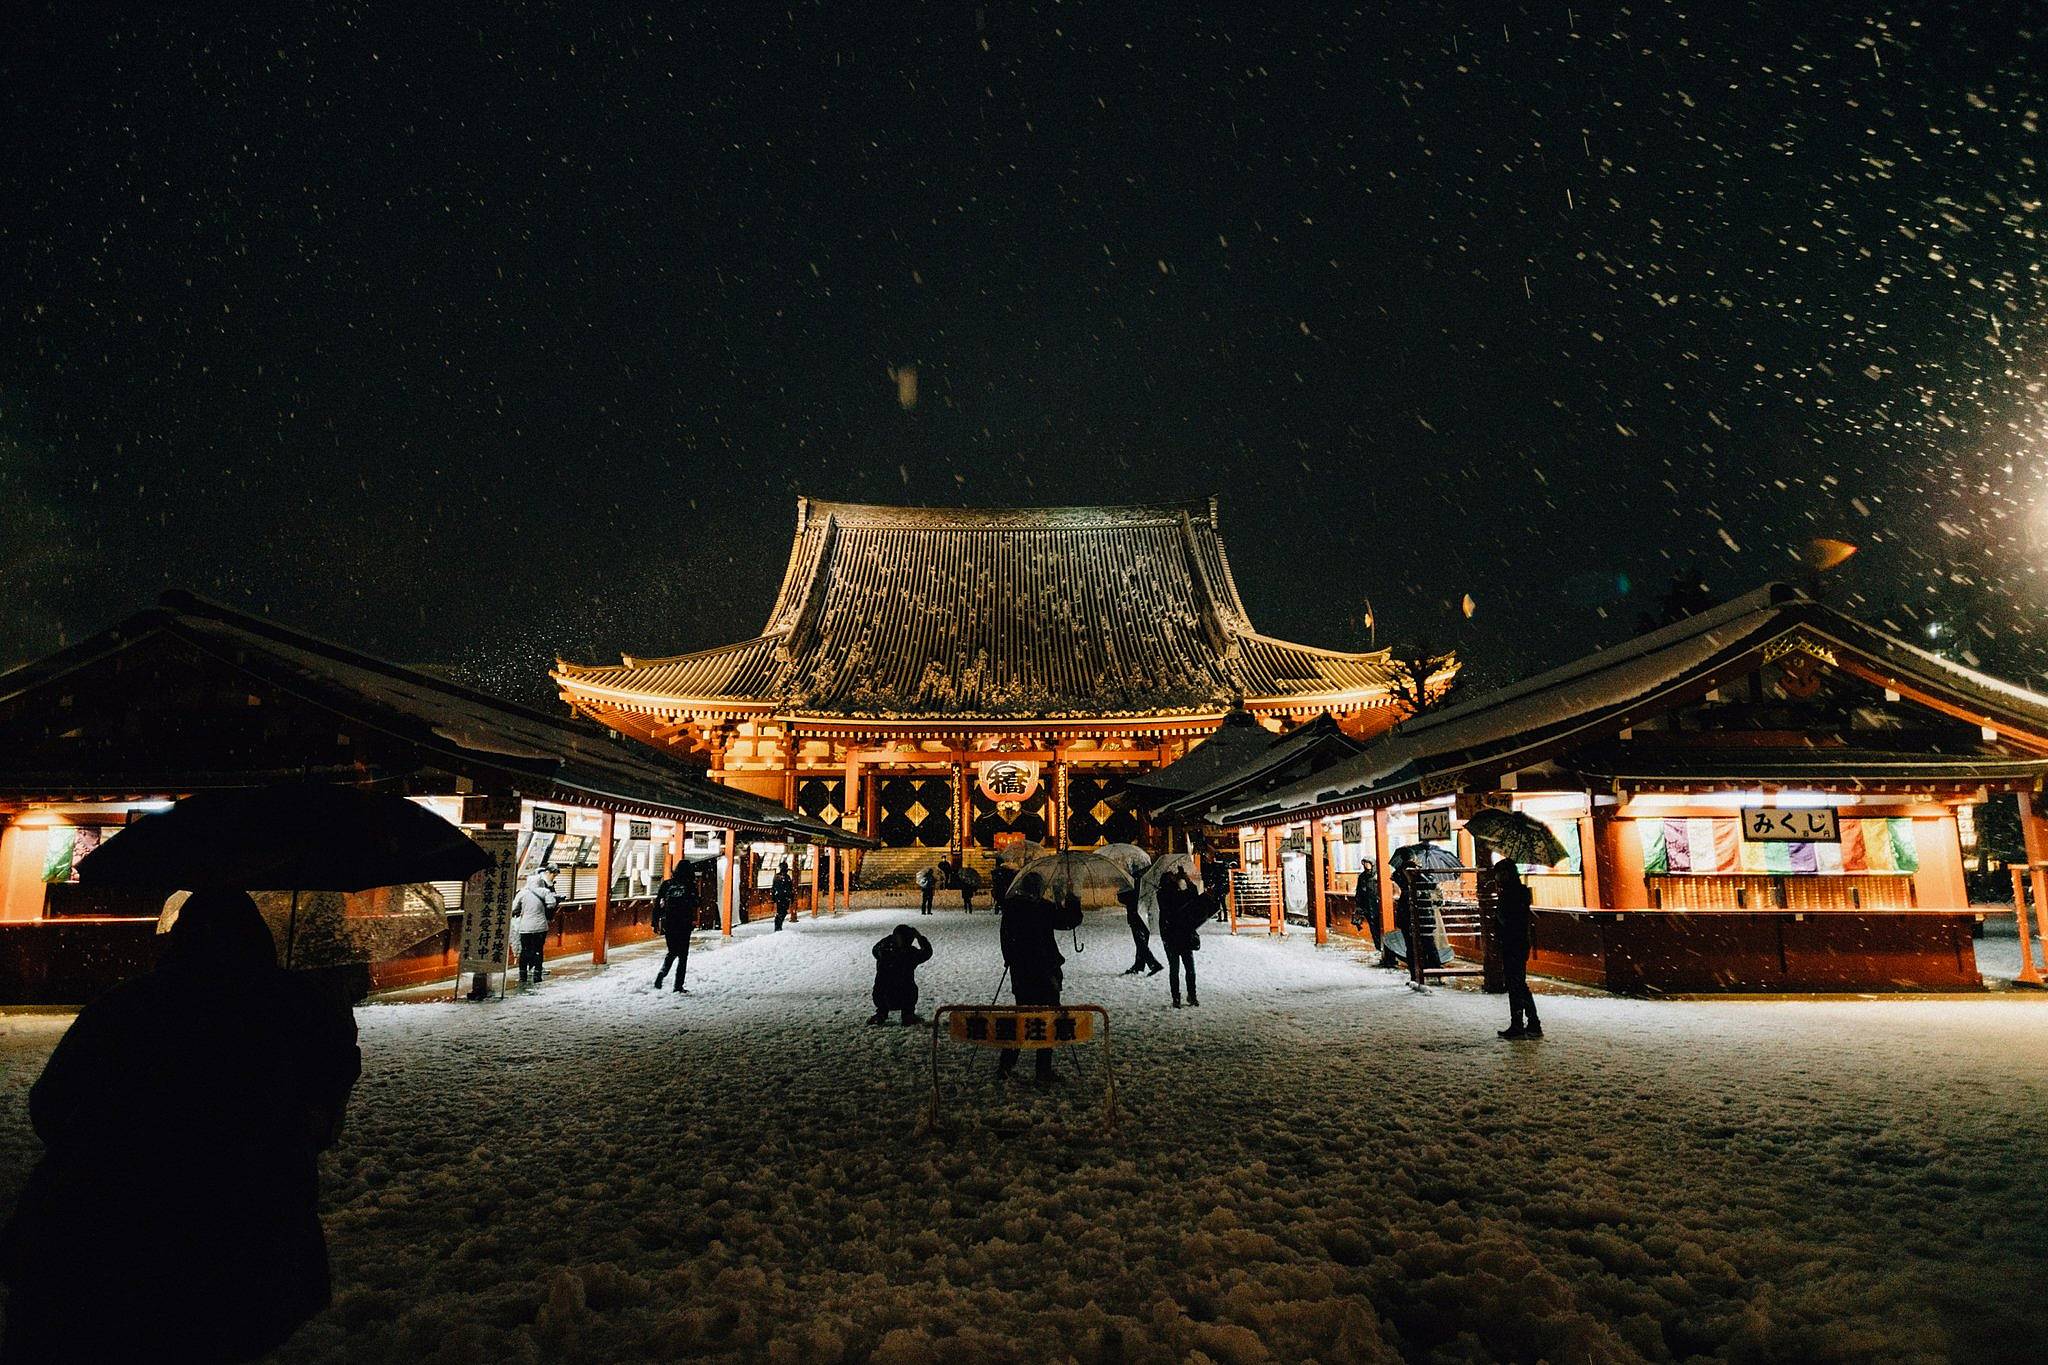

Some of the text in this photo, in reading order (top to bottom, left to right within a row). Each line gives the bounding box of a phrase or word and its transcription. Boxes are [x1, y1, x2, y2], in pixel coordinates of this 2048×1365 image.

[1423, 814, 1448, 835] みくじ
[1753, 812, 1826, 834] みくじ
